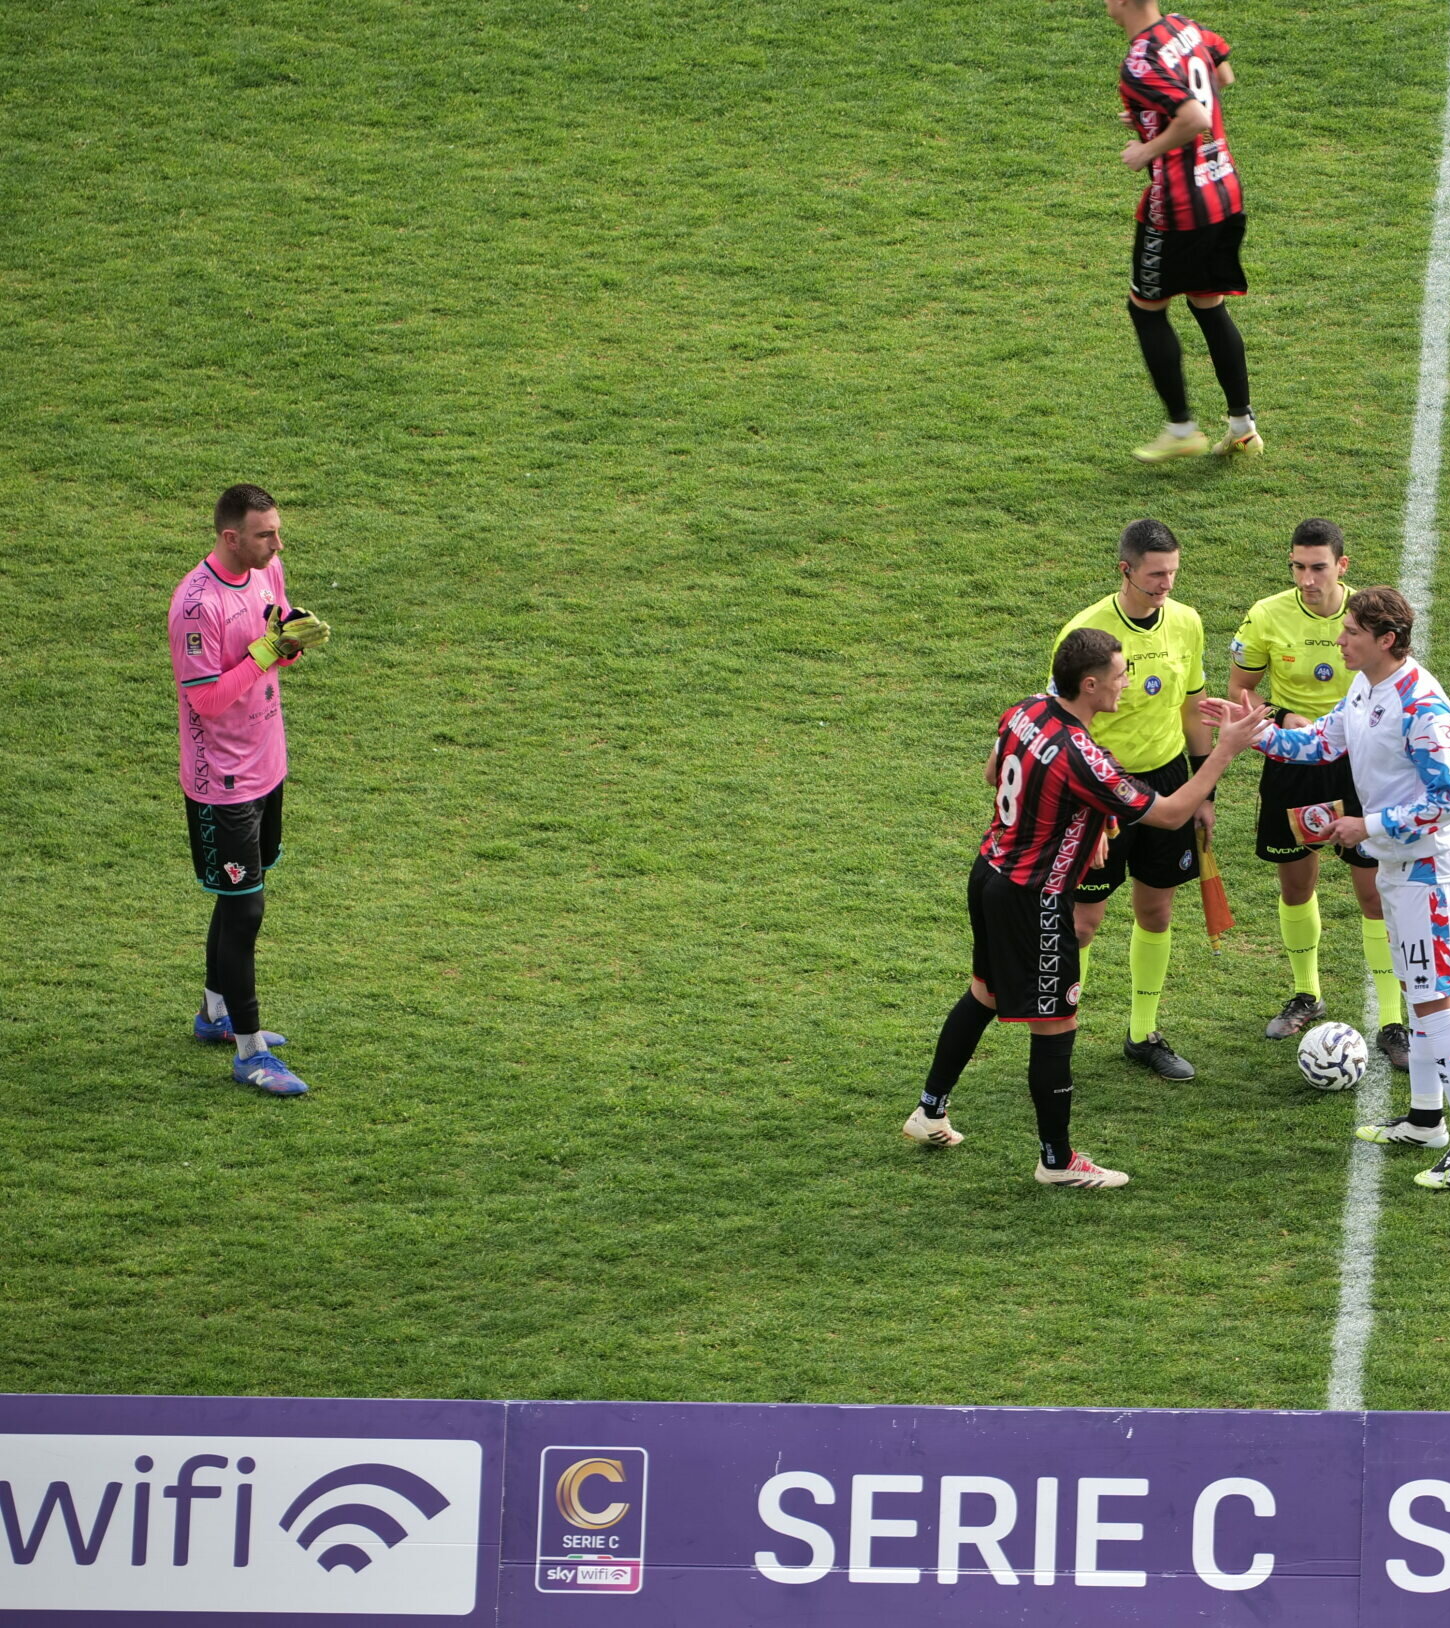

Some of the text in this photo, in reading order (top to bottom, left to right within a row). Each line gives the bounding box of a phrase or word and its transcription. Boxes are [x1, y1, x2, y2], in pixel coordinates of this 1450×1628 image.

[1304, 639, 1340, 648] GIVOV
[997, 754, 1022, 826] 8
[1401, 939, 1430, 971] 14
[0, 1454, 256, 1567] wifi
[562, 1535, 620, 1549] SERIE C
[754, 1471, 1276, 1590] SERIE C
[547, 1566, 609, 1583] sky wifi
